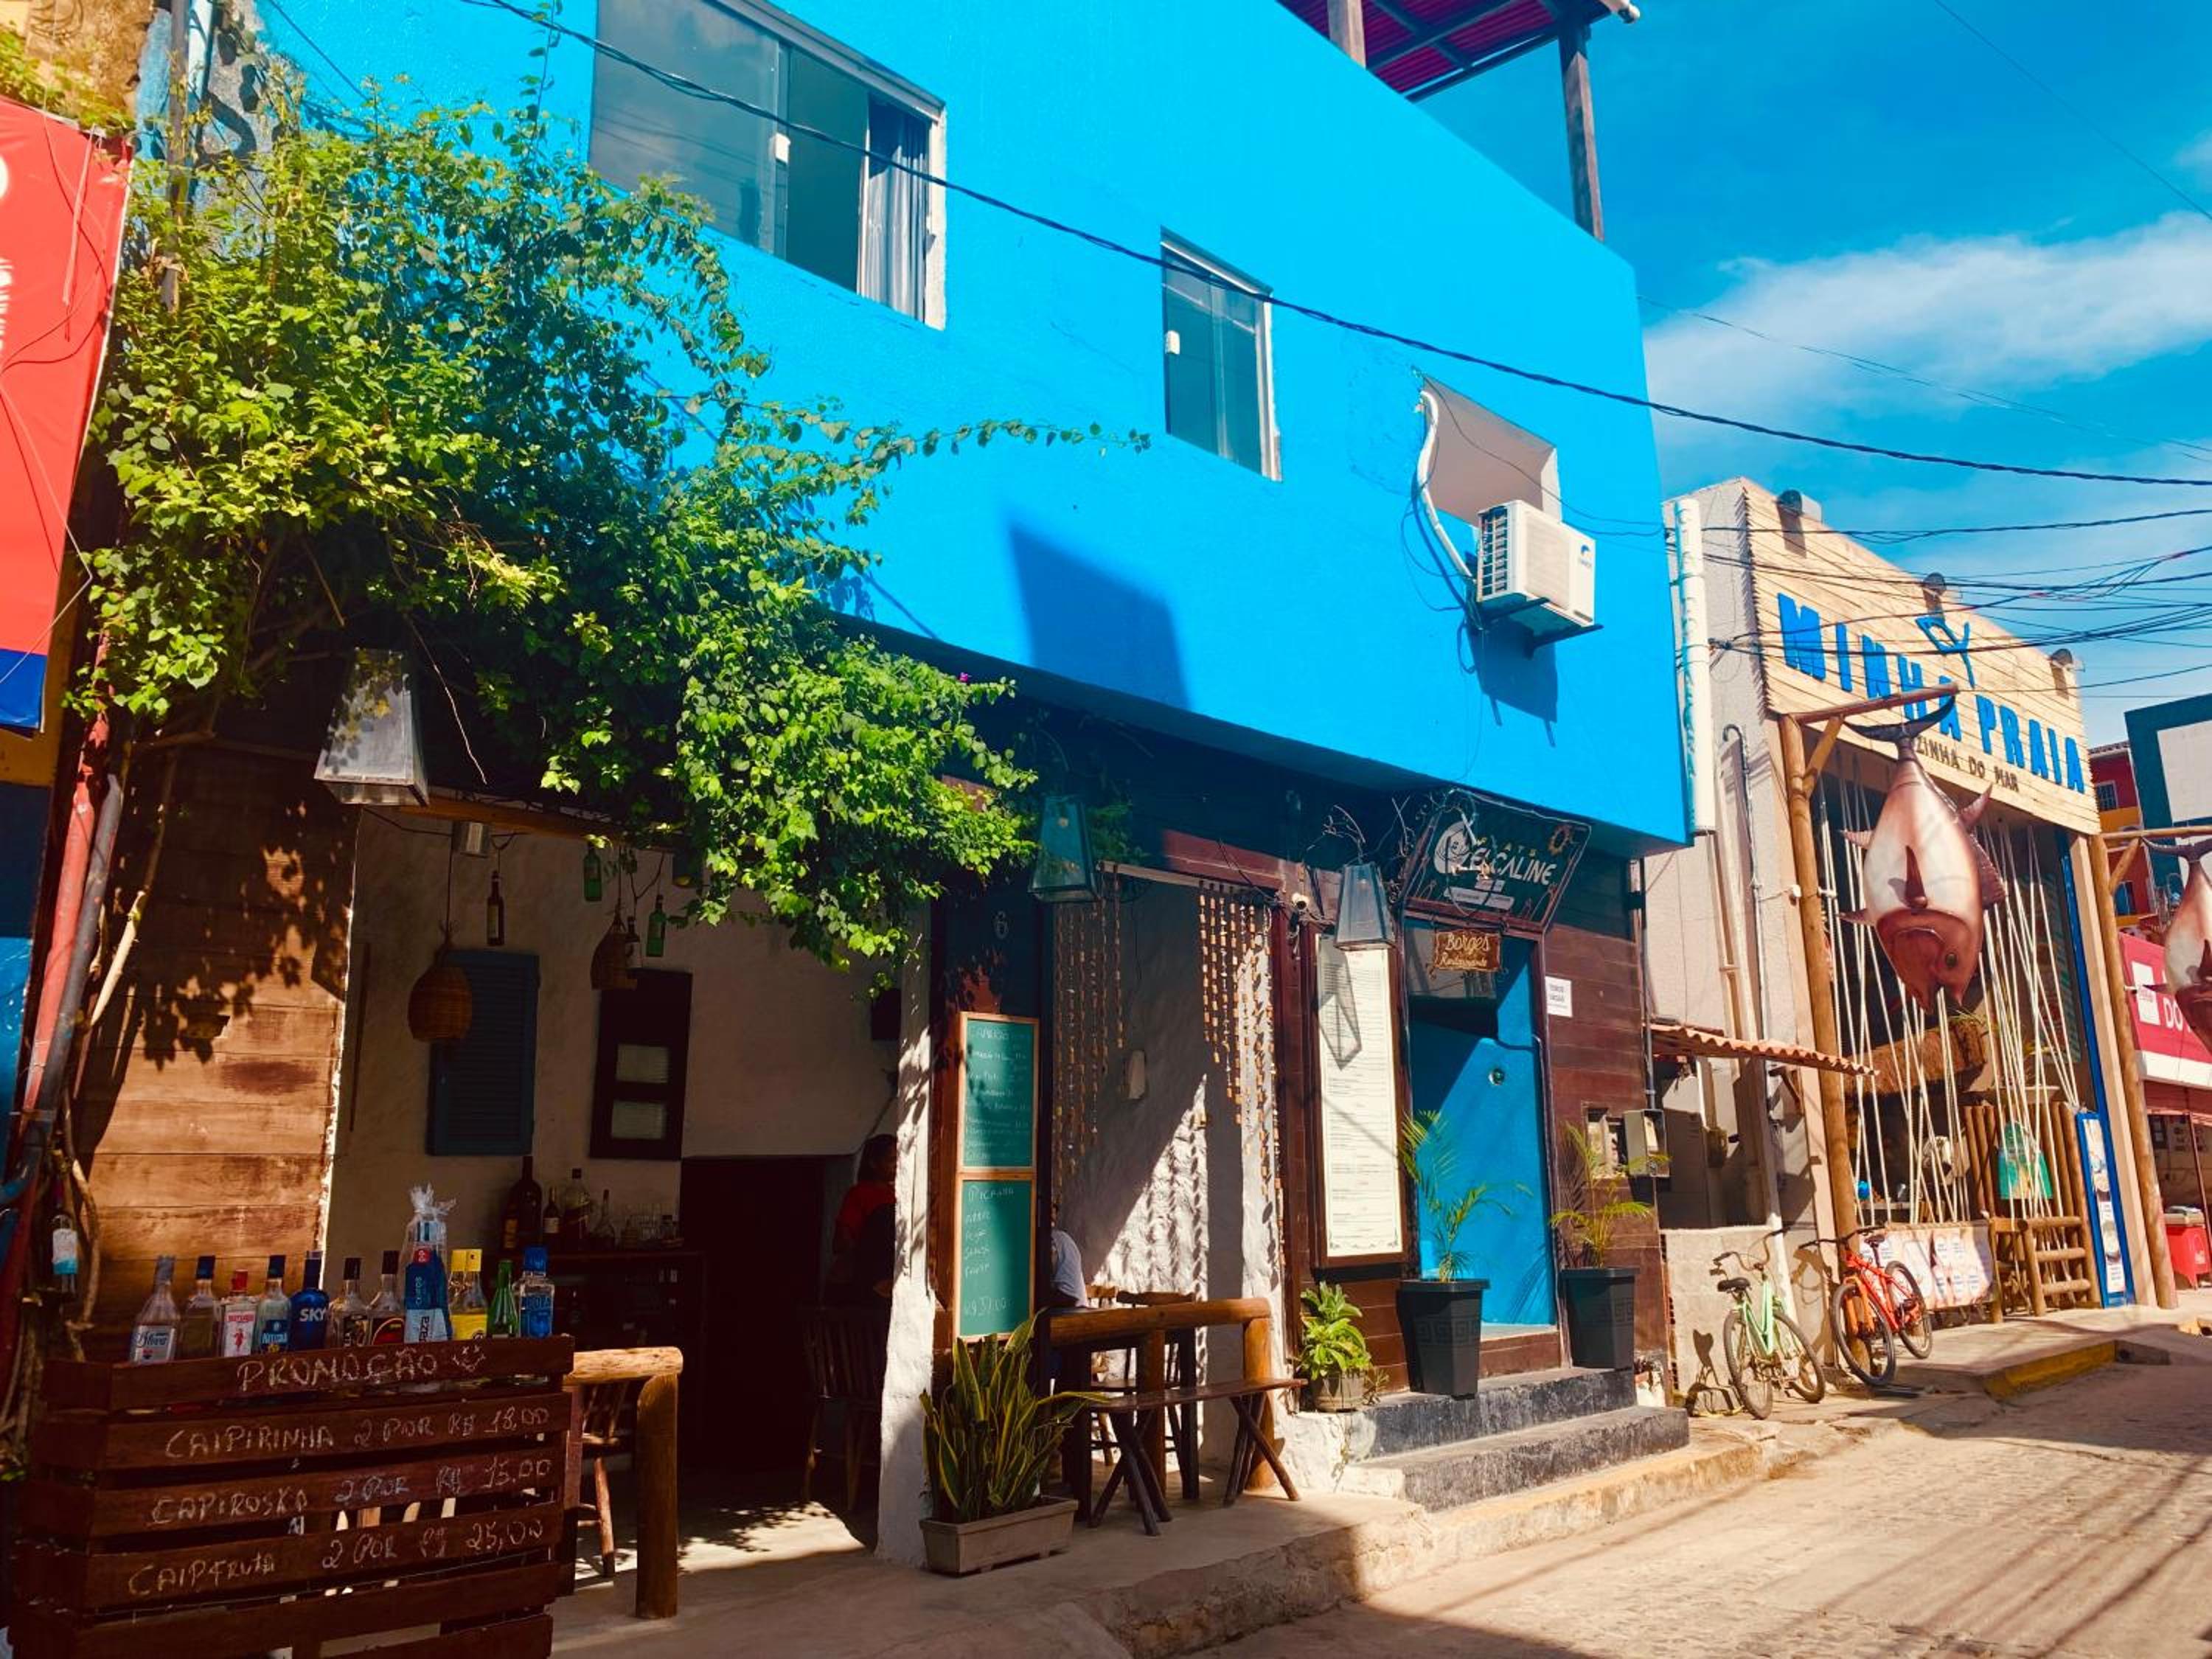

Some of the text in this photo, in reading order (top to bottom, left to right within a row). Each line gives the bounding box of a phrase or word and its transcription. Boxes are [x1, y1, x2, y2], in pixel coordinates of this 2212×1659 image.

[1777, 592, 2085, 794] MINHA PRAIA
[1968, 755, 1986, 779] DO
[1994, 765, 2020, 793] MAR
[165, 1425, 335, 1458] CAIPIRINHA
[354, 1419, 372, 1447] 2
[383, 1417, 434, 1442] POR
[335, 1479, 354, 1503] 2
[362, 1475, 410, 1500] POR
[321, 1538, 343, 1569] 2
[353, 1533, 398, 1565] POR
